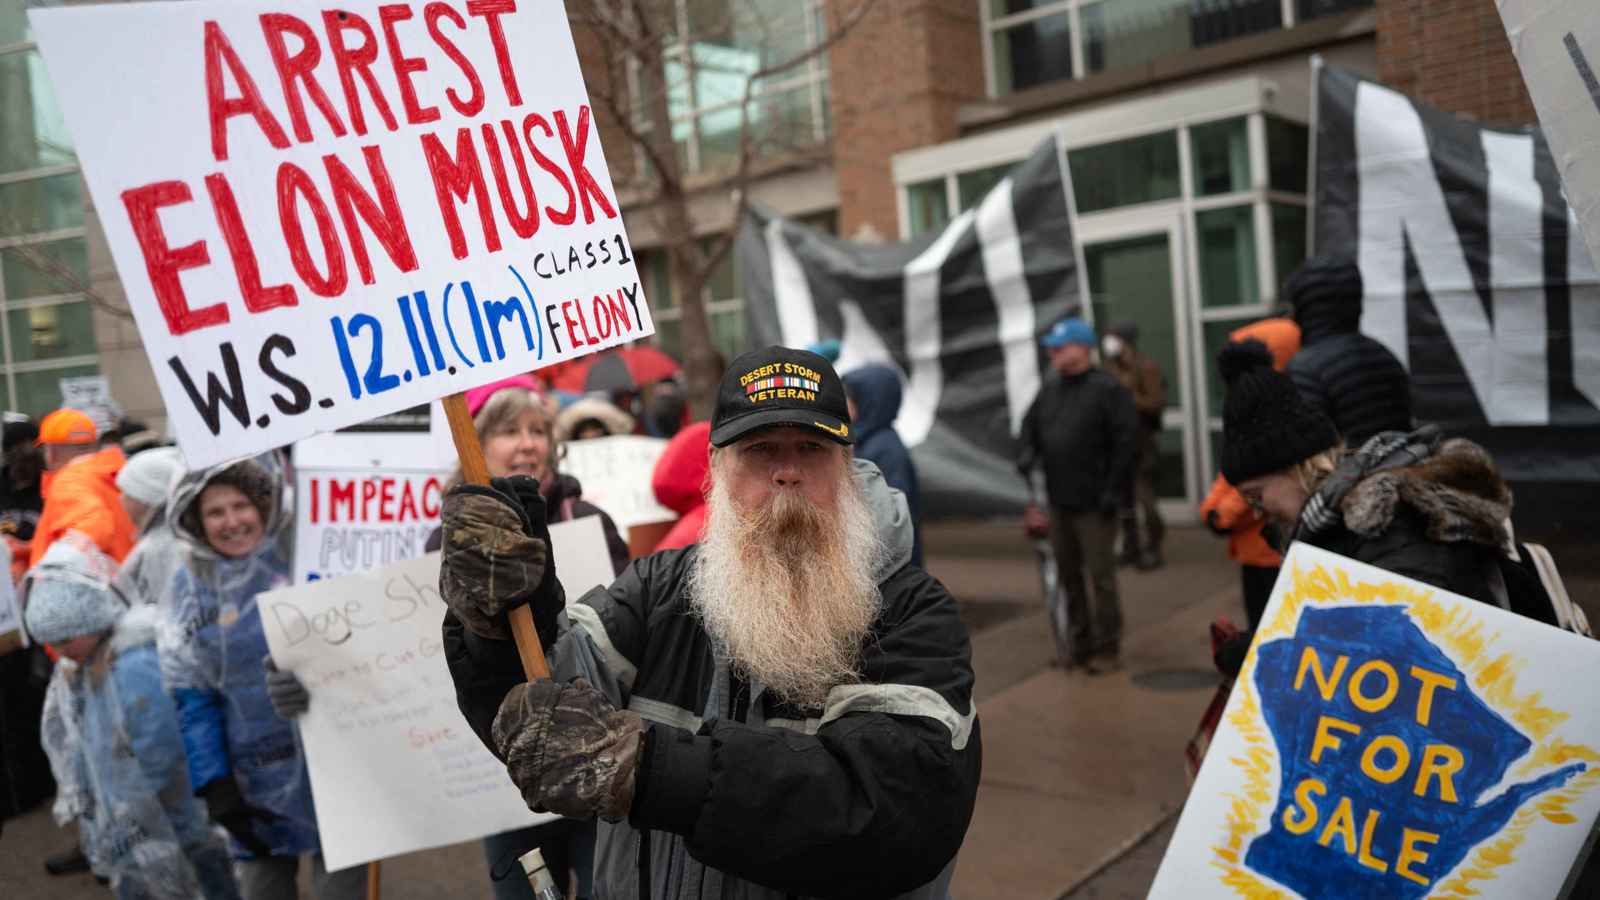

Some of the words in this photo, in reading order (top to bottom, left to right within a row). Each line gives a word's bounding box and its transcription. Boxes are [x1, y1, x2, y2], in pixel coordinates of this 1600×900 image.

[203, 0, 523, 162] ARREST
[121, 144, 419, 336] ELON
[420, 104, 617, 260] MUSK
[533, 239, 611, 278] CLASS
[613, 233, 631, 265] 1
[545, 282, 642, 353] FELONY
[168, 334, 335, 436] W.S.
[740, 362, 781, 386] DESERT
[783, 362, 821, 384] STORM
[749, 388, 816, 403] VETERAN
[309, 478, 443, 524] IMPEAC
[271, 601, 377, 646] Doge
[385, 572, 442, 622] Sh
[1294, 647, 1456, 727] NOT
[1310, 716, 1464, 803] FOR
[1283, 778, 1439, 885] SALE
